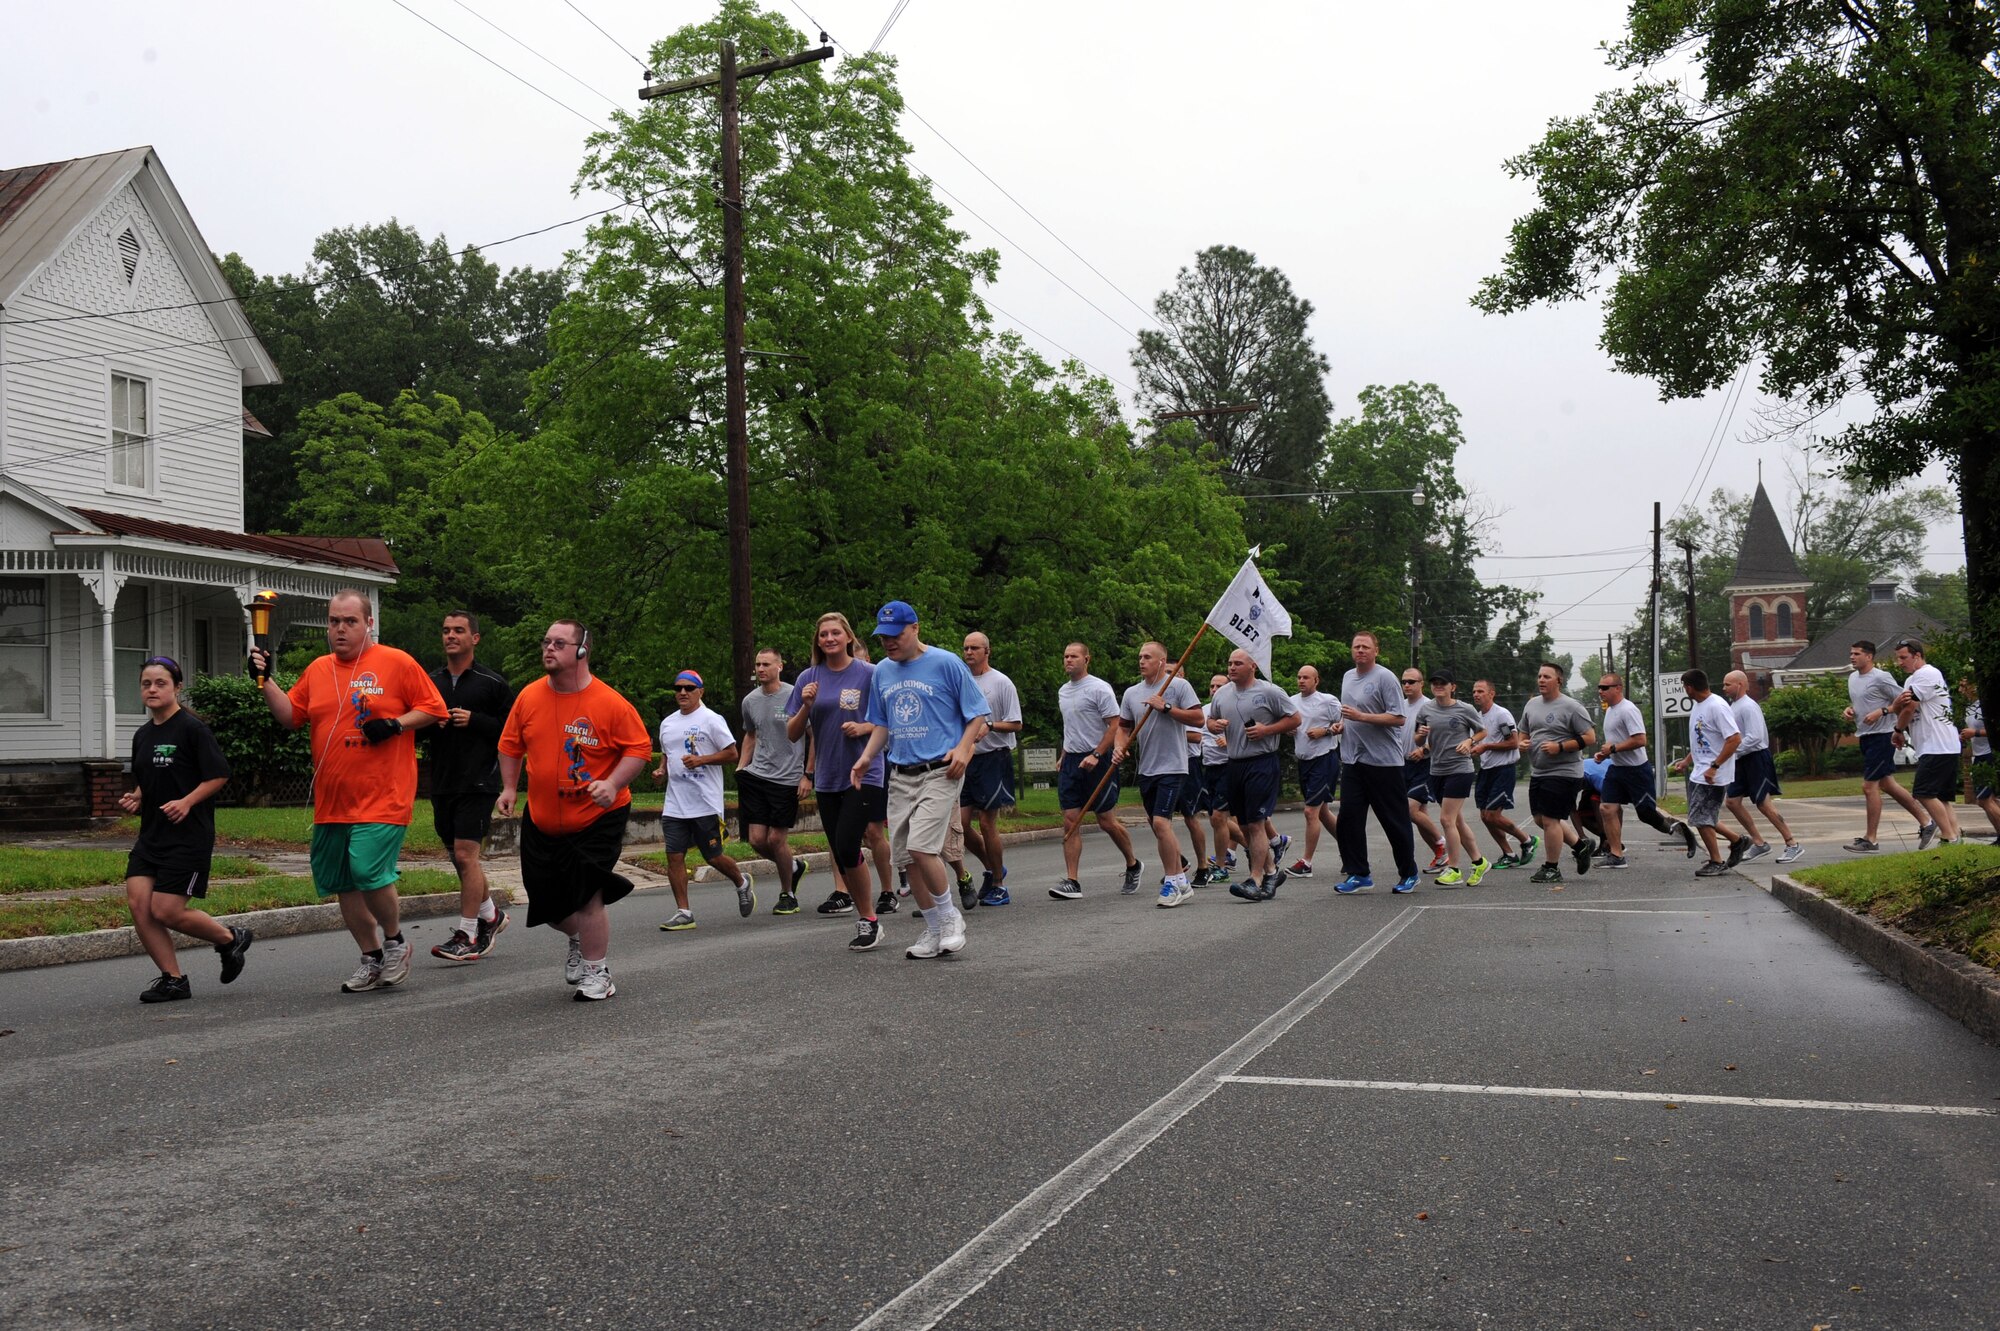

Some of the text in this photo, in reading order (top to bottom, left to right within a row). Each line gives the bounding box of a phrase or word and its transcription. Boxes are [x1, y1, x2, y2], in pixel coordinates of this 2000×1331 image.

[1229, 613, 1260, 642] BLET
[350, 680, 373, 688] TORCH
[1661, 677, 1683, 686] SPE
[366, 687, 384, 695] RUN
[903, 680, 933, 696] OLYMPICS
[1665, 697, 1693, 713] 20
[564, 724, 588, 736] TORCH
[902, 726, 929, 734] CAROLINA
[580, 736, 599, 746] RUN
